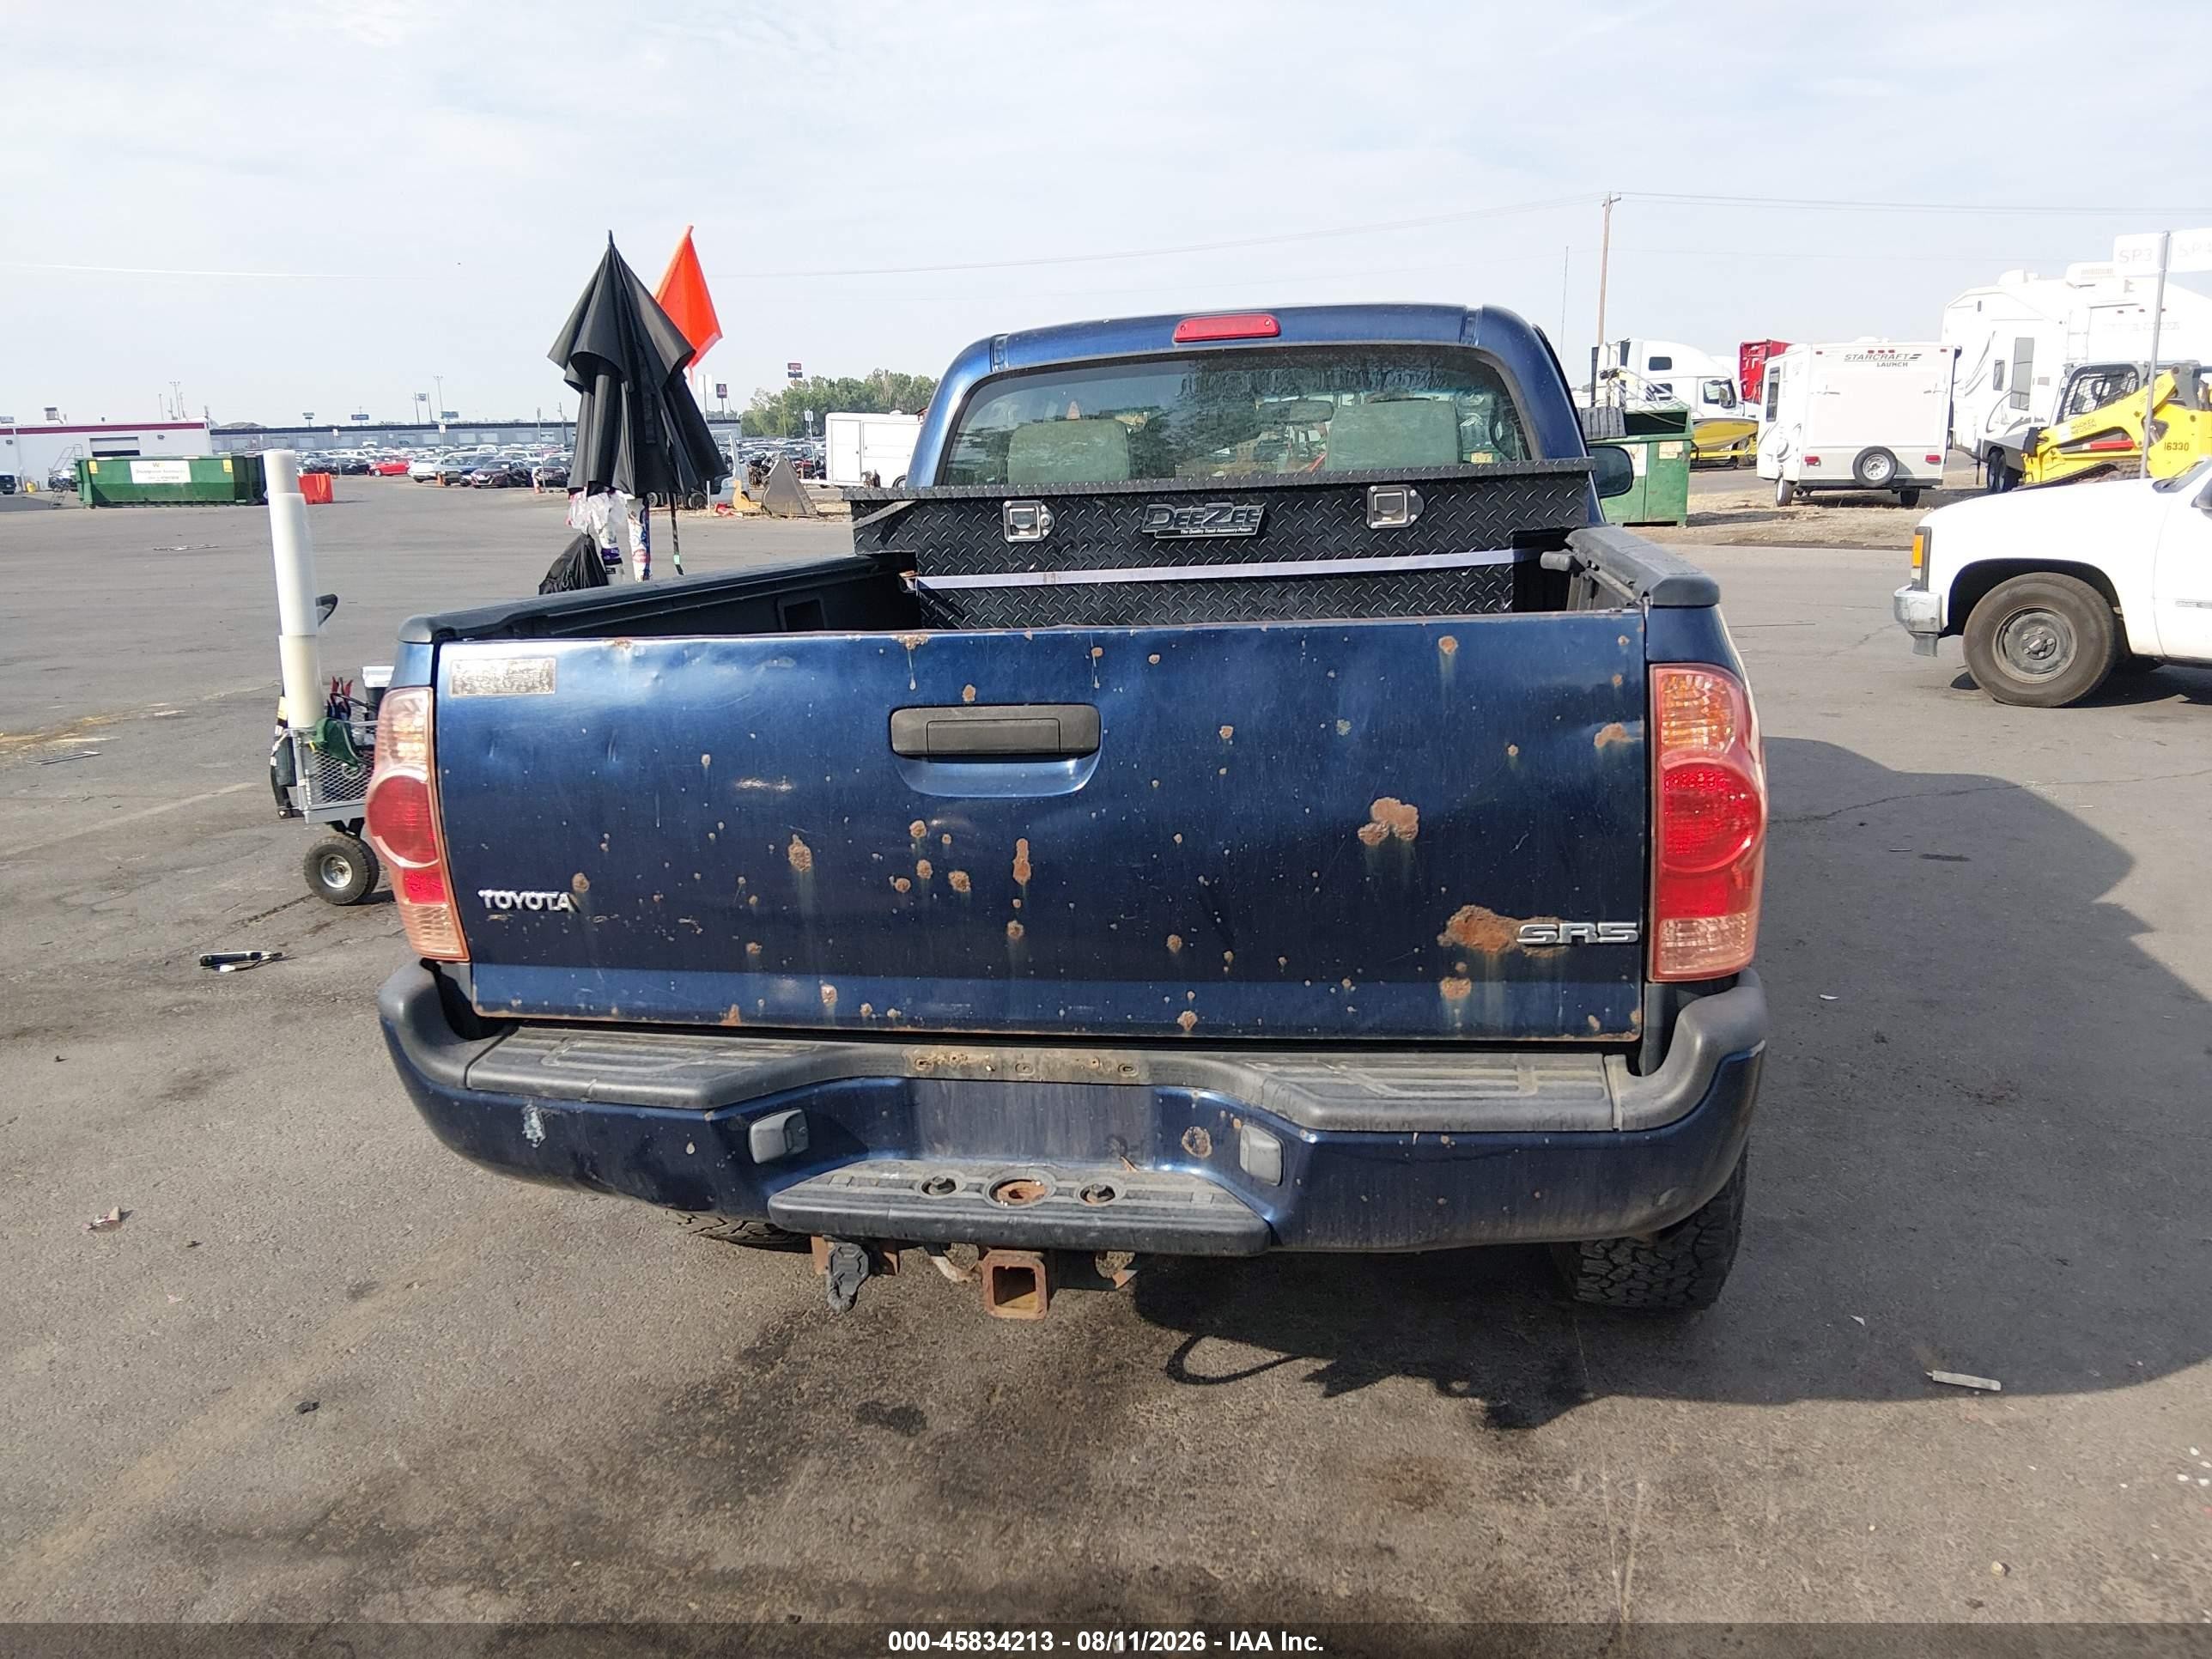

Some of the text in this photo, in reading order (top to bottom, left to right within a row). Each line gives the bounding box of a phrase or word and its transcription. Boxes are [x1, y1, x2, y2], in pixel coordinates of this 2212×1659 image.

[2118, 248, 2154, 264] SP3
[2163, 441, 2190, 452] 16330
[477, 890, 575, 913] TOYOTA
[1516, 921, 1639, 945] SR5
